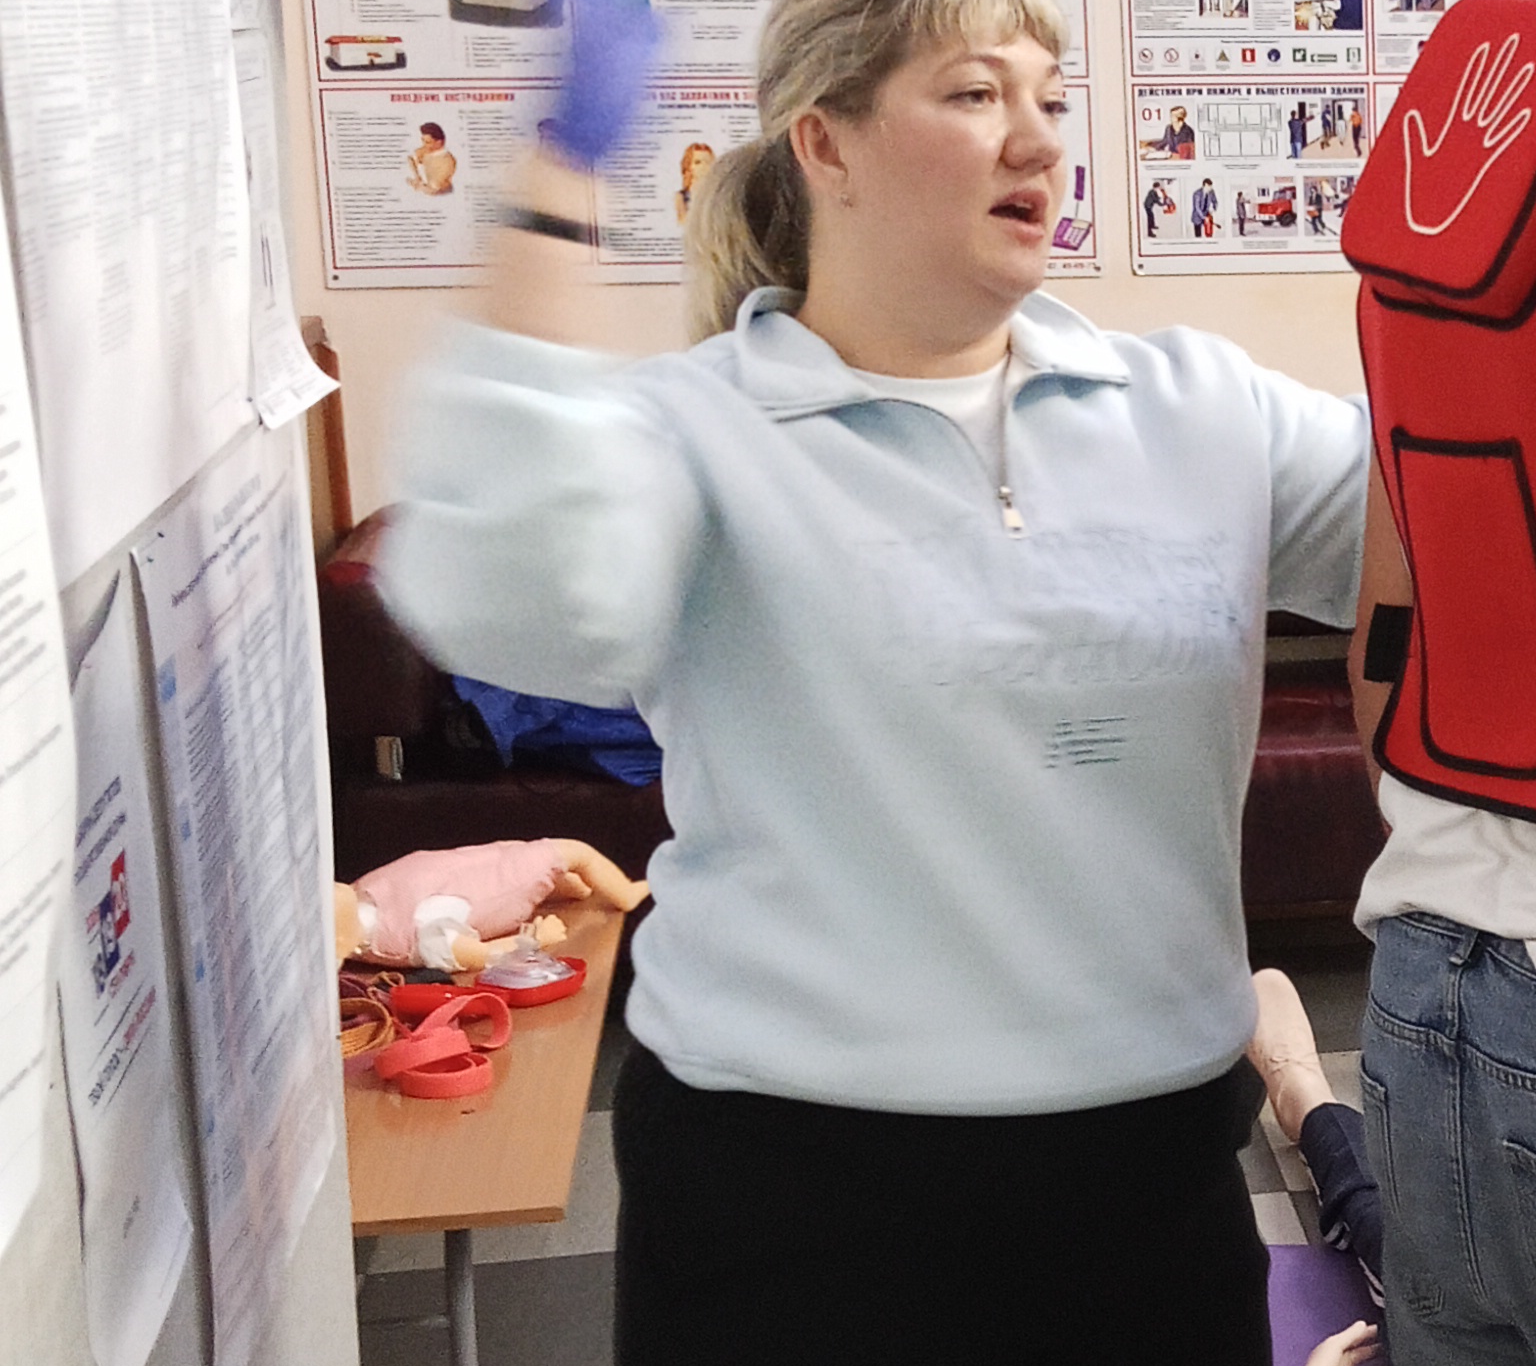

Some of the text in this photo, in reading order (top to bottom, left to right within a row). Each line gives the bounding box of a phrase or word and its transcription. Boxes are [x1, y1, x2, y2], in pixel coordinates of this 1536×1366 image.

[1138, 88, 1183, 97] ДЕЙСТВИЯ
[1186, 88, 1204, 96] ПРИ
[1207, 88, 1243, 96] ПОЖАРЕ
[1255, 87, 1327, 96] ОБЩЕСТВЕННОМ
[1330, 86, 1365, 95] ЗДАНИИ
[1140, 107, 1163, 122] 01
